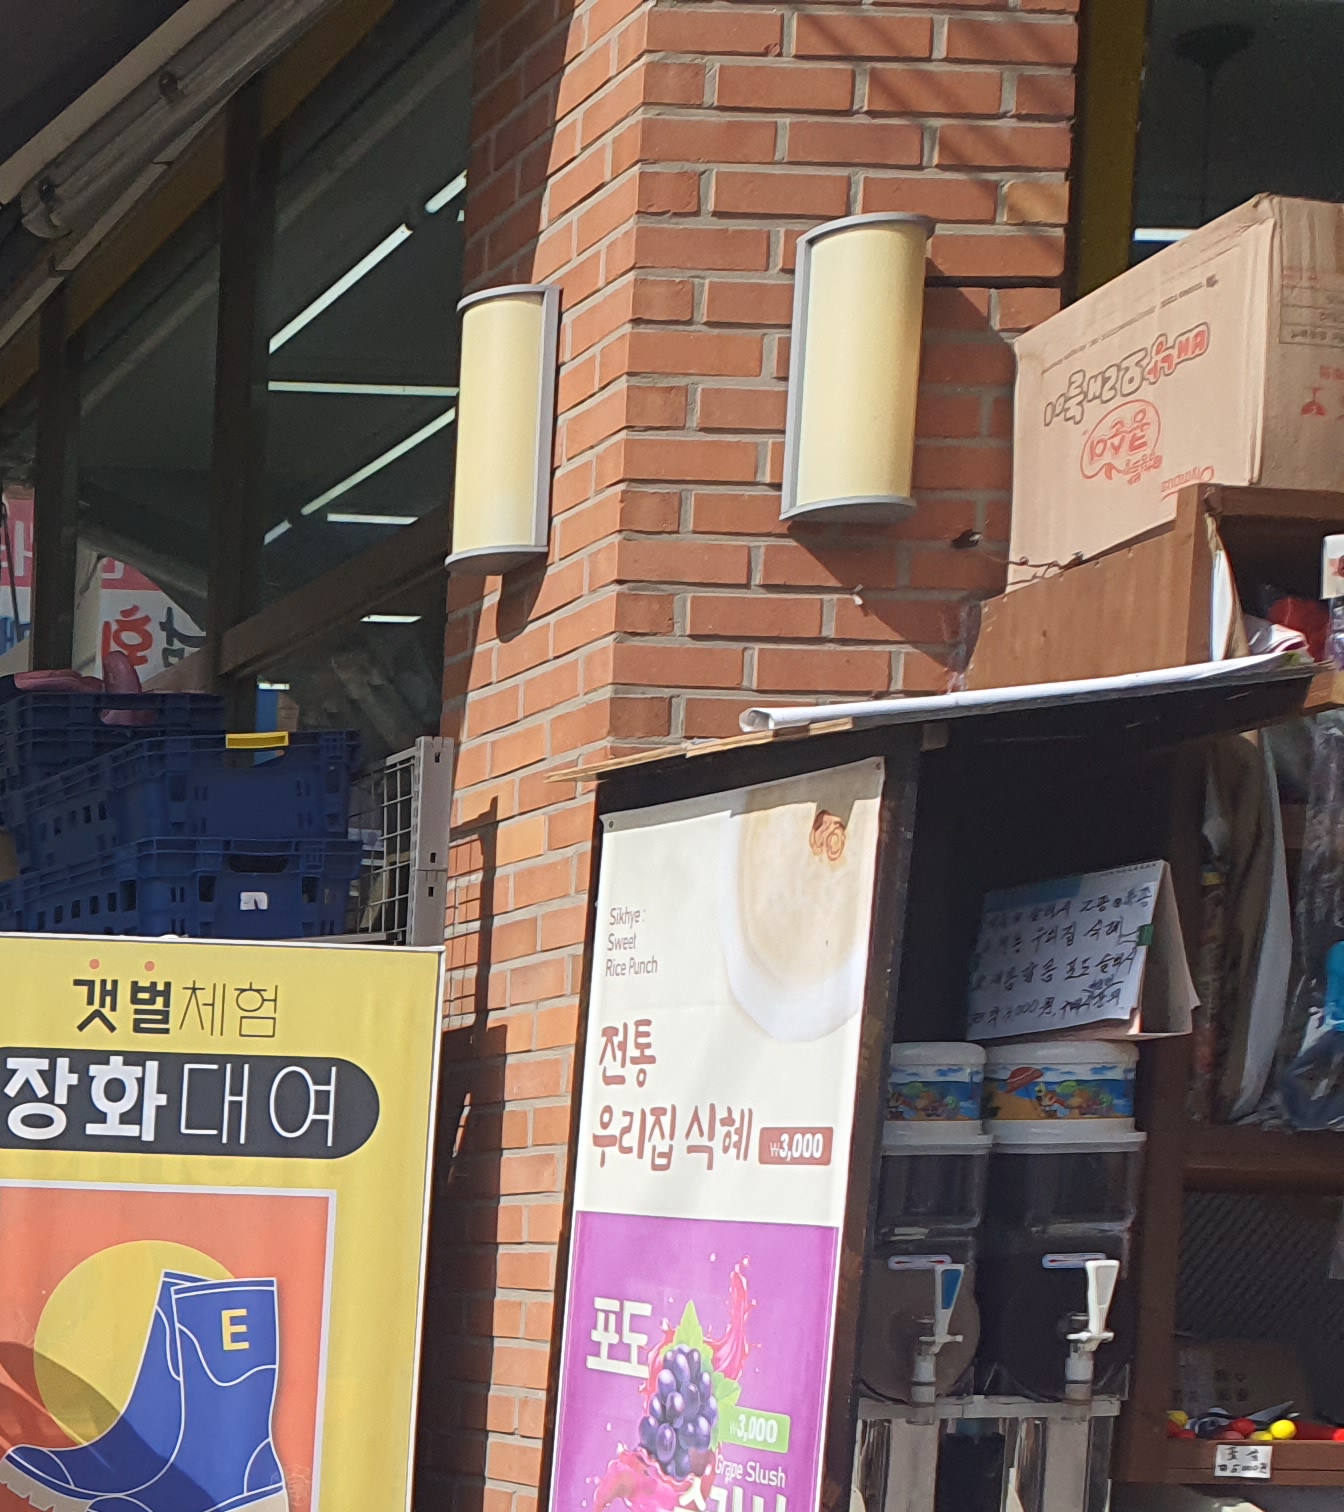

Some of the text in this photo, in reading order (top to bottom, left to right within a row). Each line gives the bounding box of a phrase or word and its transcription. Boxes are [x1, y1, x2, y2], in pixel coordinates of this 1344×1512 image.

[605, 956, 658, 977] Rice Punch
[607, 933, 637, 951] Sweet
[599, 1019, 656, 1087] 전통
[3, 1055, 337, 1147] 장화대여
[593, 1103, 676, 1172] 우리집
[684, 1102, 753, 1171] 식혜
[221, 1309, 250, 1351] E
[586, 1296, 653, 1379] 포도
[746, 1461, 786, 1487] Slush
